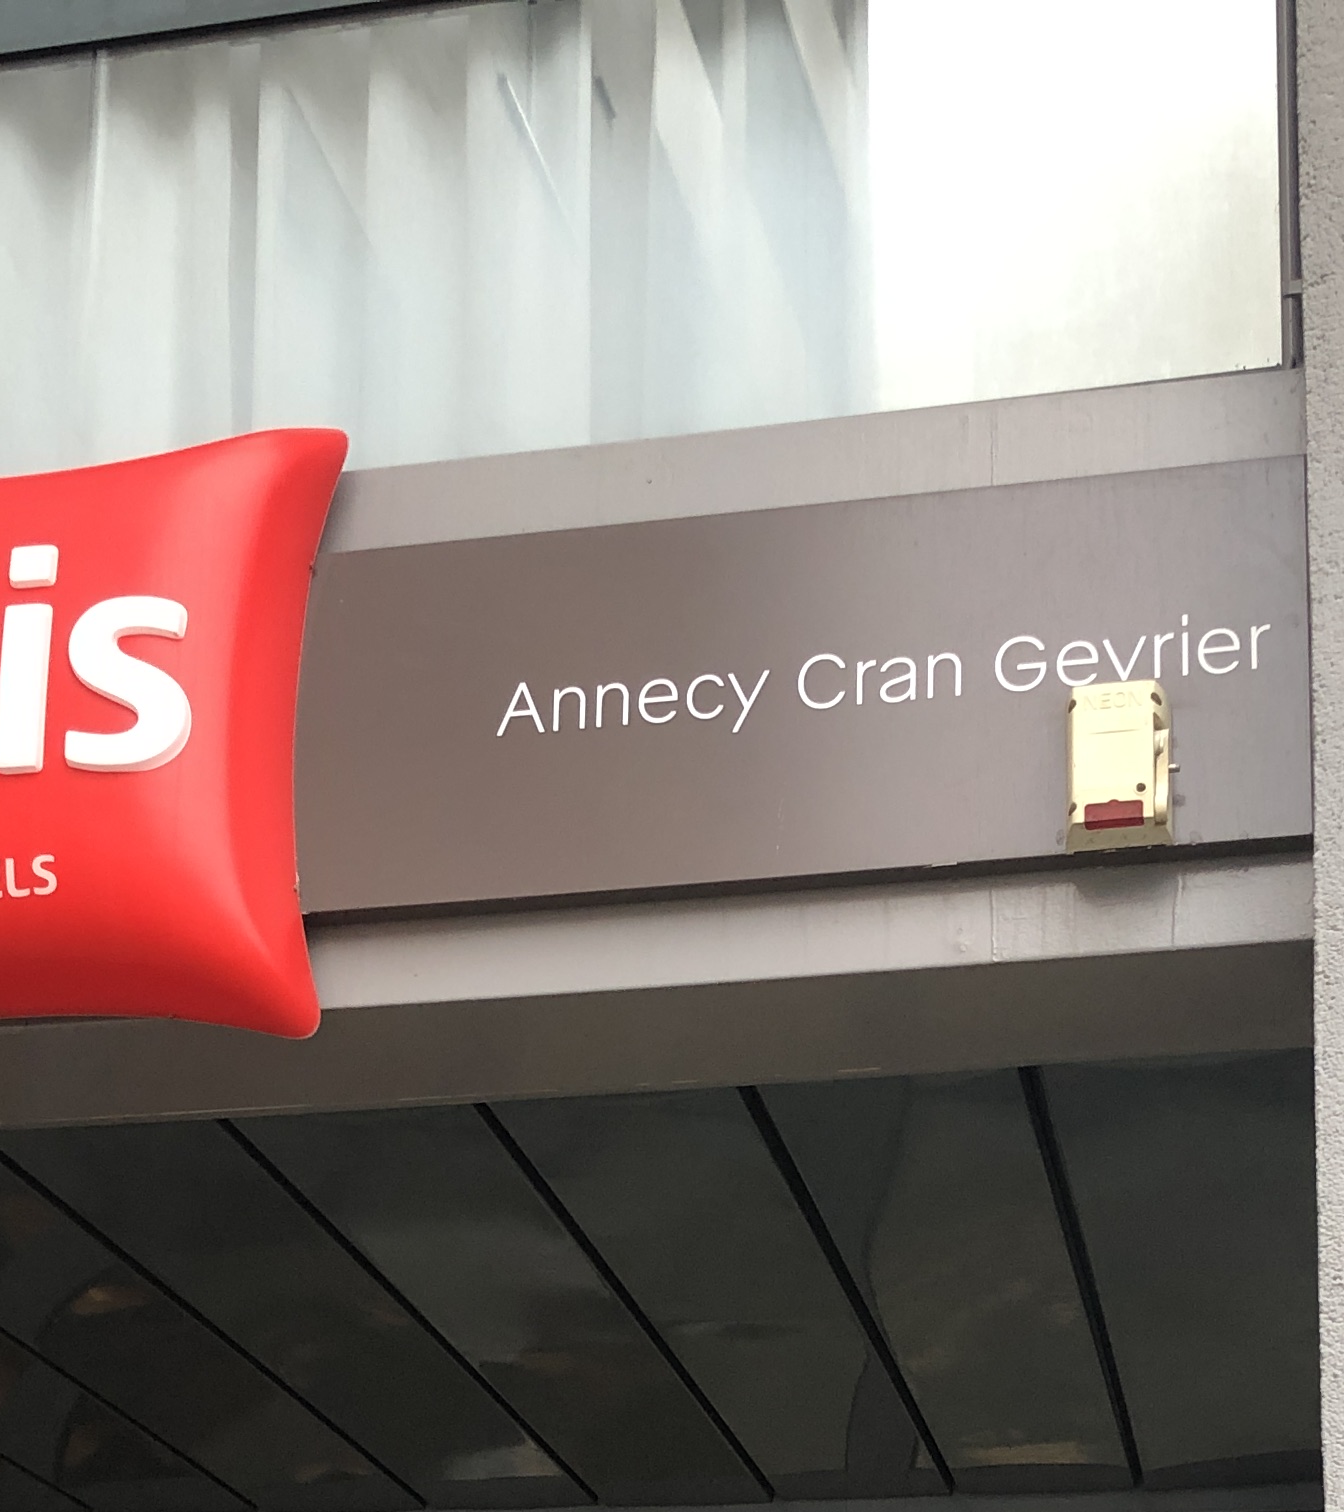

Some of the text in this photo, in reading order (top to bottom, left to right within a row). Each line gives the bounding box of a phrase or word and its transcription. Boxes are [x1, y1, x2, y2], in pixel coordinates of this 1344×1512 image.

[496, 615, 1271, 737] Annecy Cran Gevrier
[1082, 690, 1143, 712] NEON
